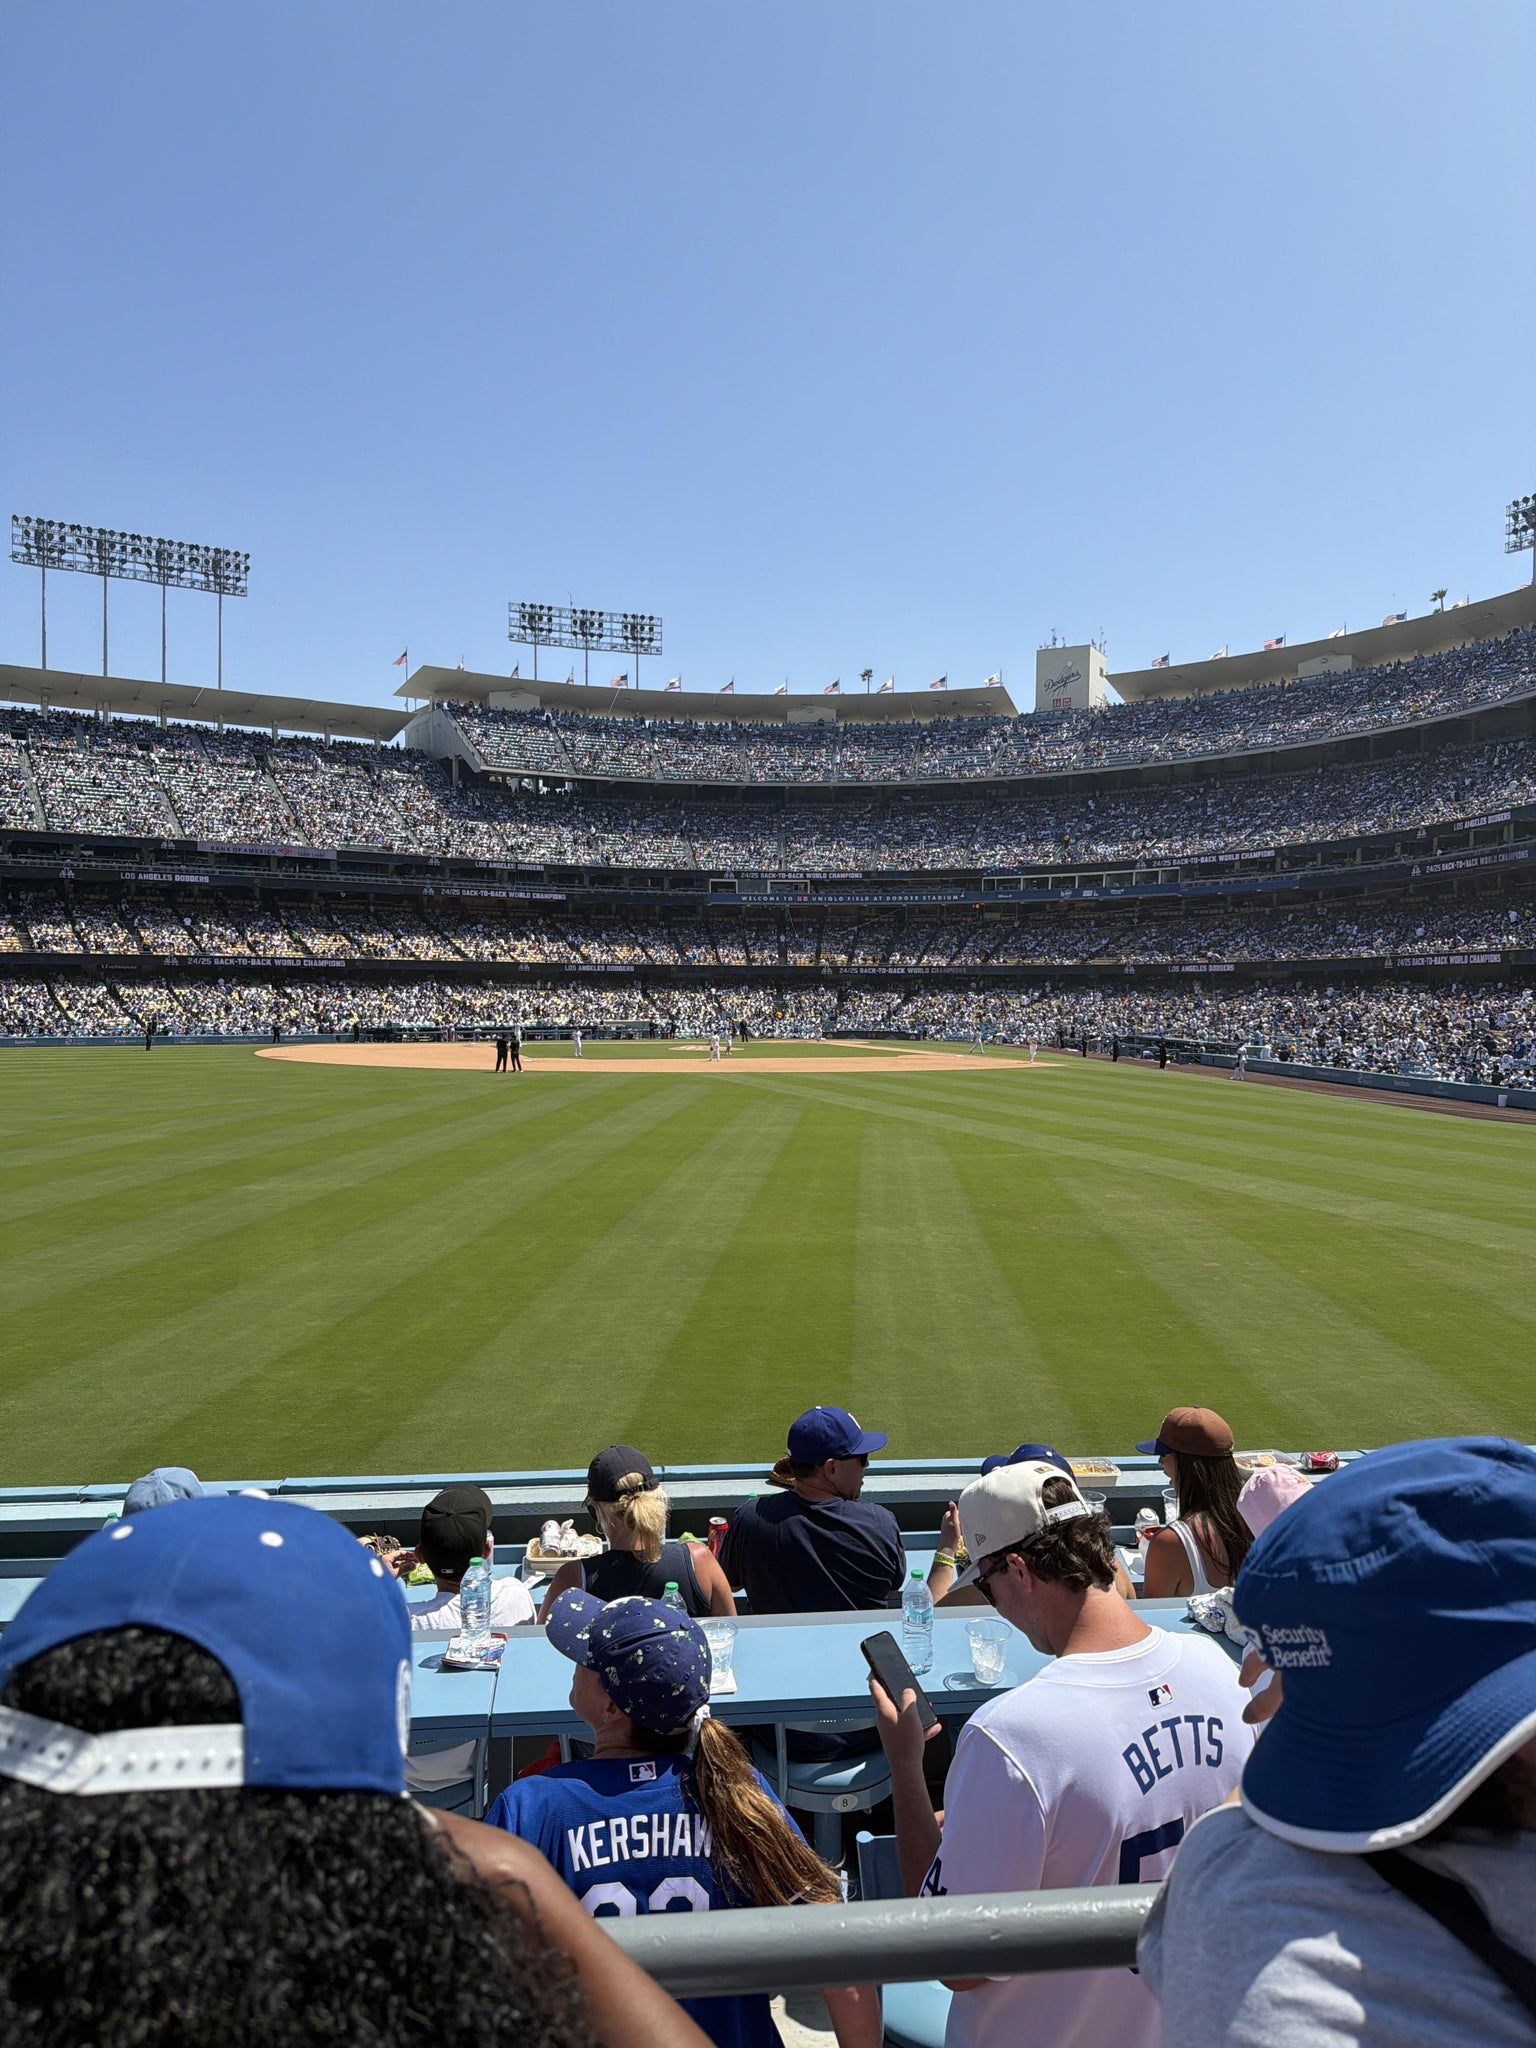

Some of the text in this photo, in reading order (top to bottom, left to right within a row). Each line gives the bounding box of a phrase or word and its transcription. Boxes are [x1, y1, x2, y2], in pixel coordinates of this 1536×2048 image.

[1043, 670, 1081, 692] Dodgers
[1453, 811, 1512, 831] LOS ANGELES DODGERS
[1172, 856, 1217, 866] BACK-TO-BACK
[1218, 853, 1240, 861] WORLD
[1241, 850, 1275, 859] CHAMPIONS
[488, 862, 516, 870] ANGELES
[517, 863, 545, 871] DODGERS
[1425, 864, 1441, 874] 24/25
[137, 873, 173, 881] ANGELES
[174, 875, 210, 883] DODGERS
[440, 888, 567, 900] 24/25 BACK-TO-BACK WORLD CHAMPIONS
[187, 957, 346, 967] 24/25 BACK-TO-BACK WORLD CHAMPIONS
[1397, 958, 1411, 966] 24/25
[1449, 955, 1468, 965] WORLD
[1208, 964, 1235, 972] DODGERS
[1262, 1624, 1328, 1648] Security
[1122, 1714, 1223, 1796] BETTS
[842, 1798, 848, 1807] 8
